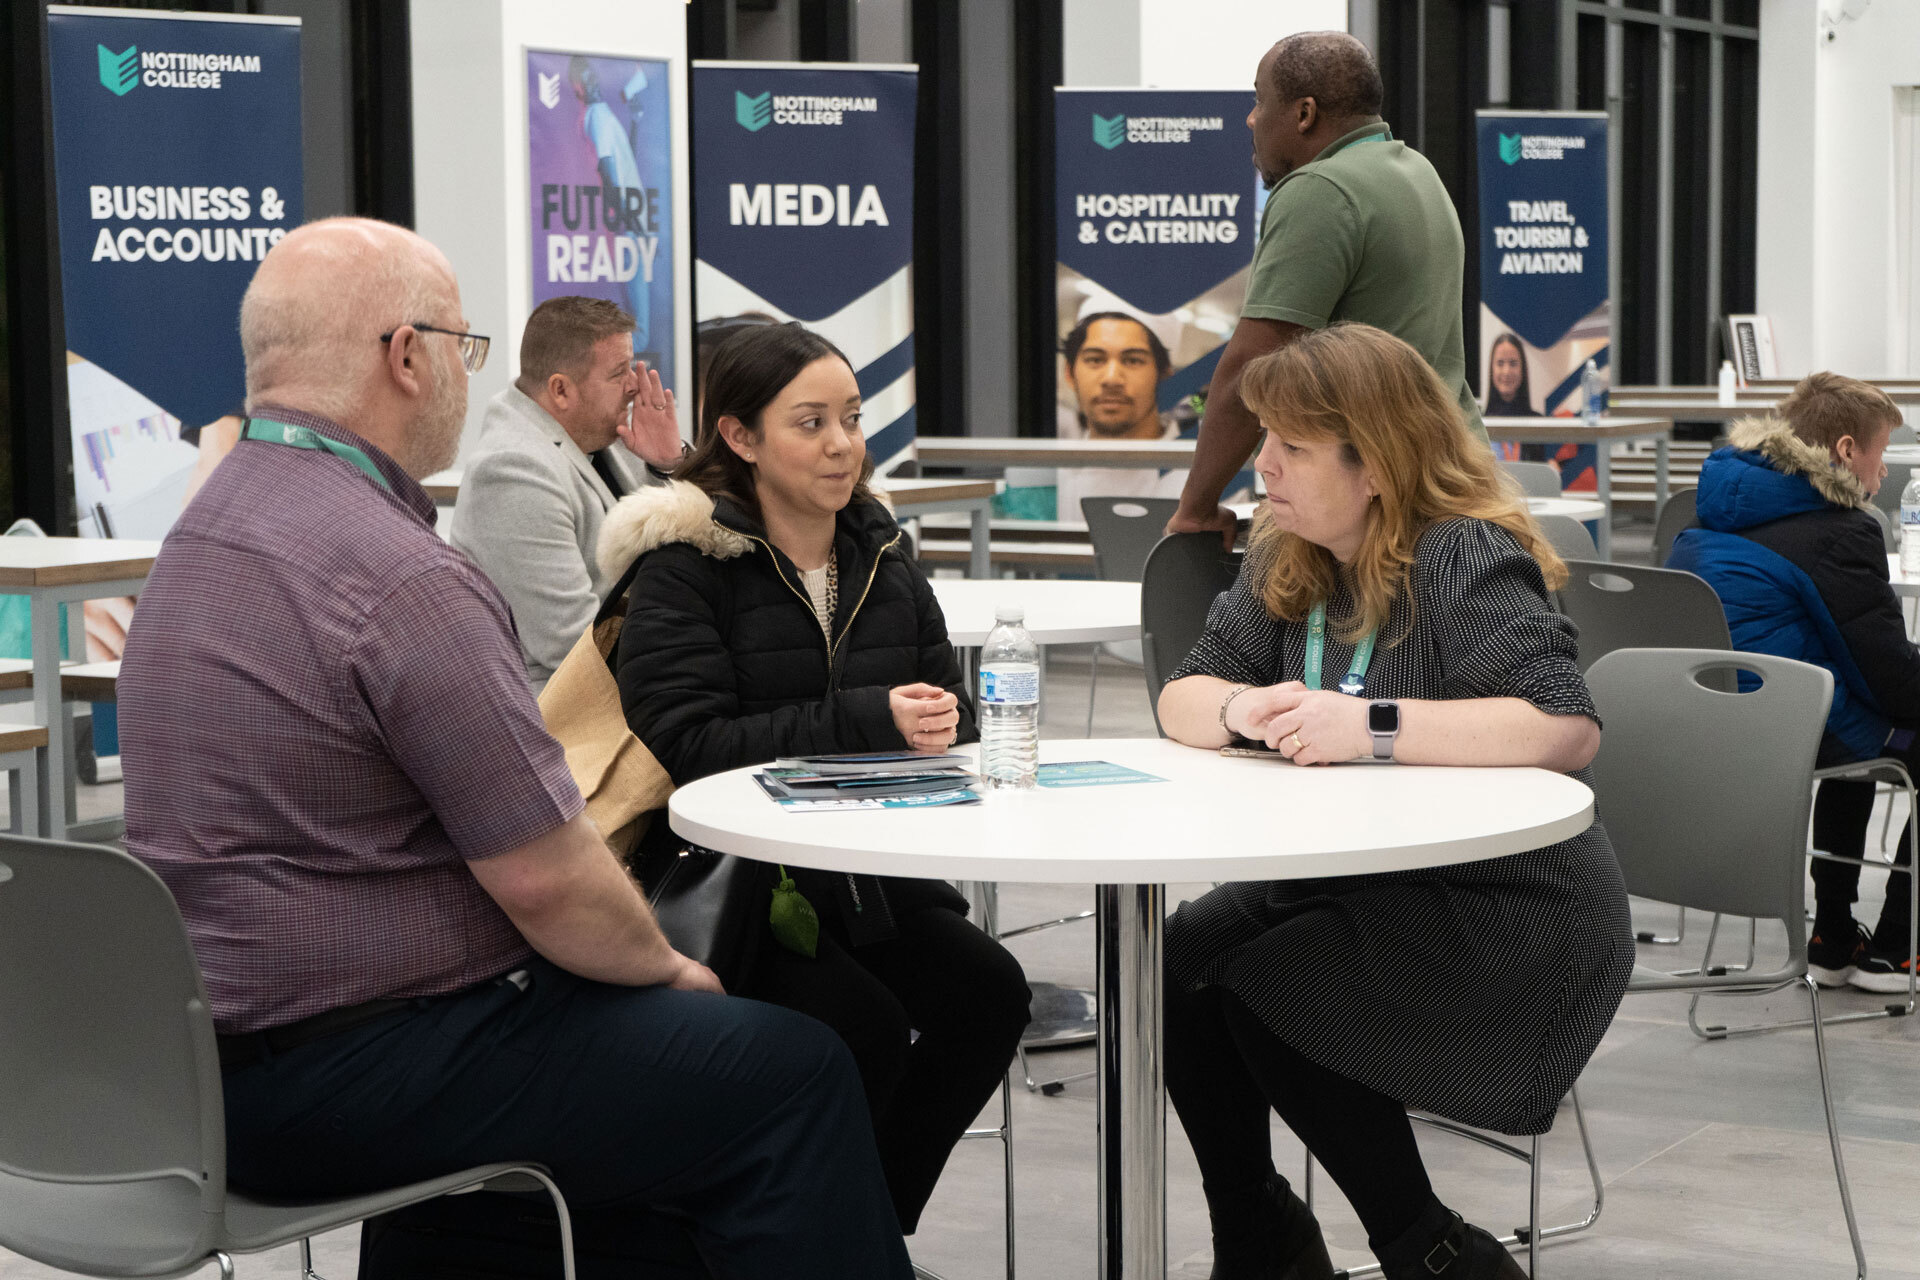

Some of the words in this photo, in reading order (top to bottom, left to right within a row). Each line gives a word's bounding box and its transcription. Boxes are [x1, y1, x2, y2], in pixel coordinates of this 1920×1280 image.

[141, 52, 260, 72] NOTTINGHAM
[142, 70, 222, 88] COLLEGE
[773, 96, 877, 112] NOTTINGHAM
[773, 111, 842, 125] COLLEGE
[1127, 117, 1223, 131] NOTTINGHAM
[1127, 129, 1191, 143] COLLEGE
[1521, 136, 1586, 149] NOTTINGHAM
[89, 185, 252, 221] BUSINESS
[259, 187, 285, 221] &
[541, 184, 660, 233] FUTURE
[729, 184, 890, 227] MEDIA
[1076, 194, 1241, 218] HOSPITALITY
[1508, 200, 1576, 226] TRAVEL,
[1077, 220, 1099, 244] &
[1105, 220, 1239, 245] CATERING
[1494, 226, 1571, 249] TOURISM
[1574, 226, 1589, 248] &
[547, 234, 659, 283] READY
[1500, 252, 1583, 275] AVIATION
